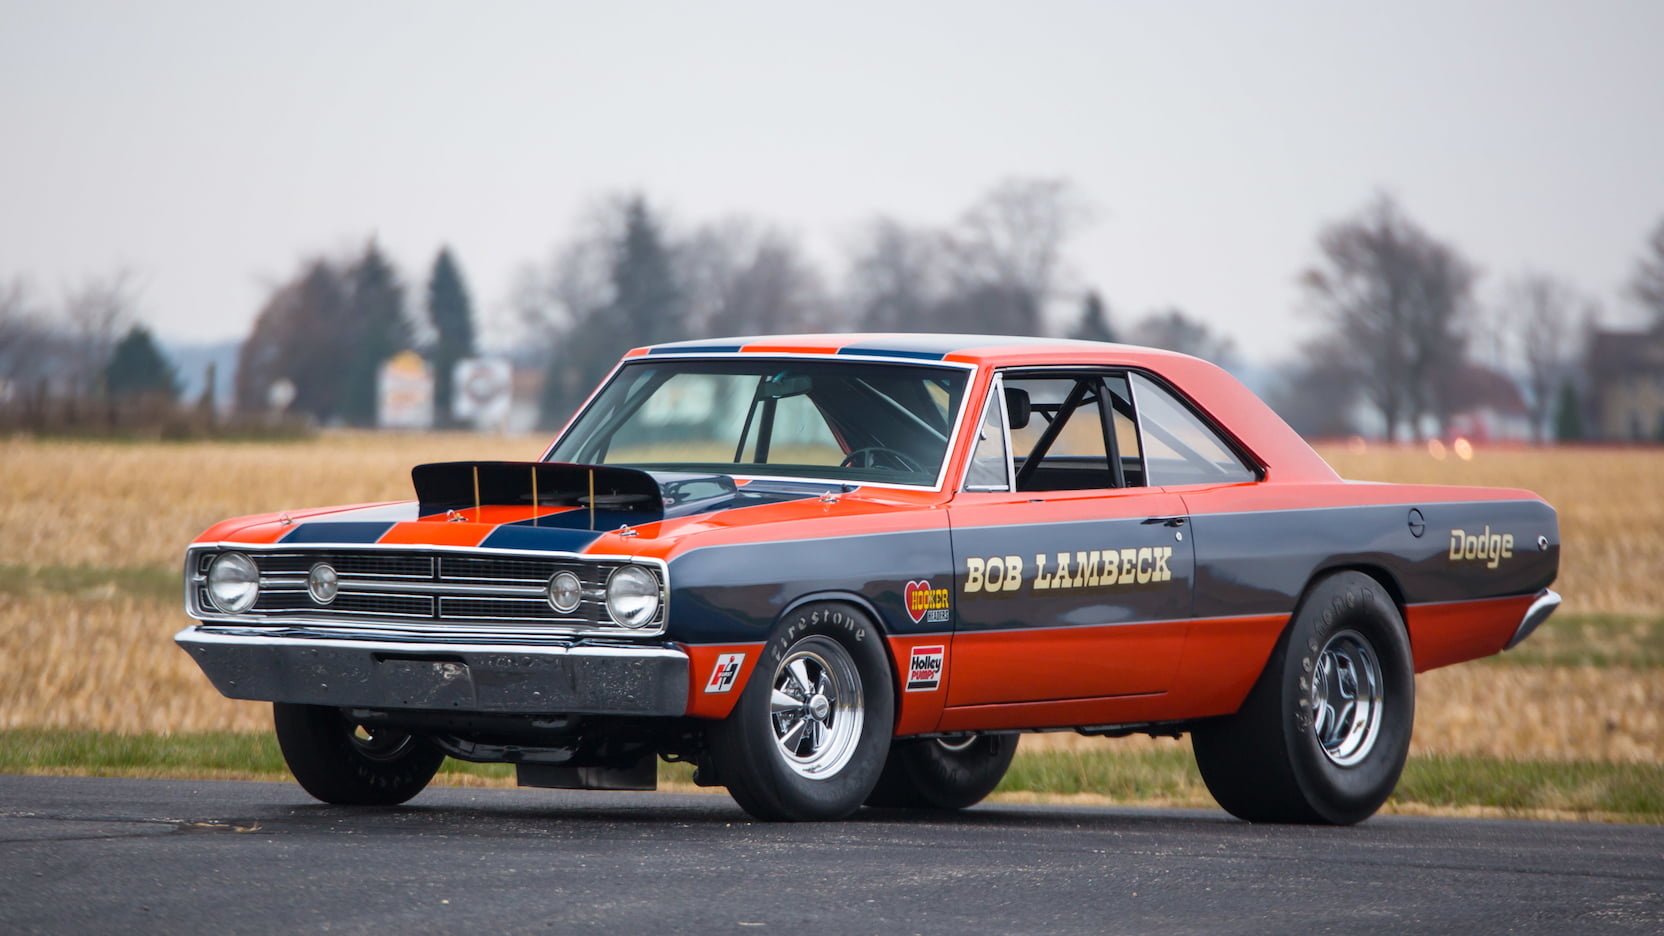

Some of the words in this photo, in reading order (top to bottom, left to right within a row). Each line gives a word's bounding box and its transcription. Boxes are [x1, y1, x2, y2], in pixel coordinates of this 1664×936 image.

[1449, 525, 1513, 568] Dodge
[964, 556, 1023, 593] BOB
[1033, 546, 1172, 590] LAMBECK
[911, 589, 949, 610] HOOKER
[911, 655, 941, 673] Holley
[911, 670, 935, 680] PUMPS
